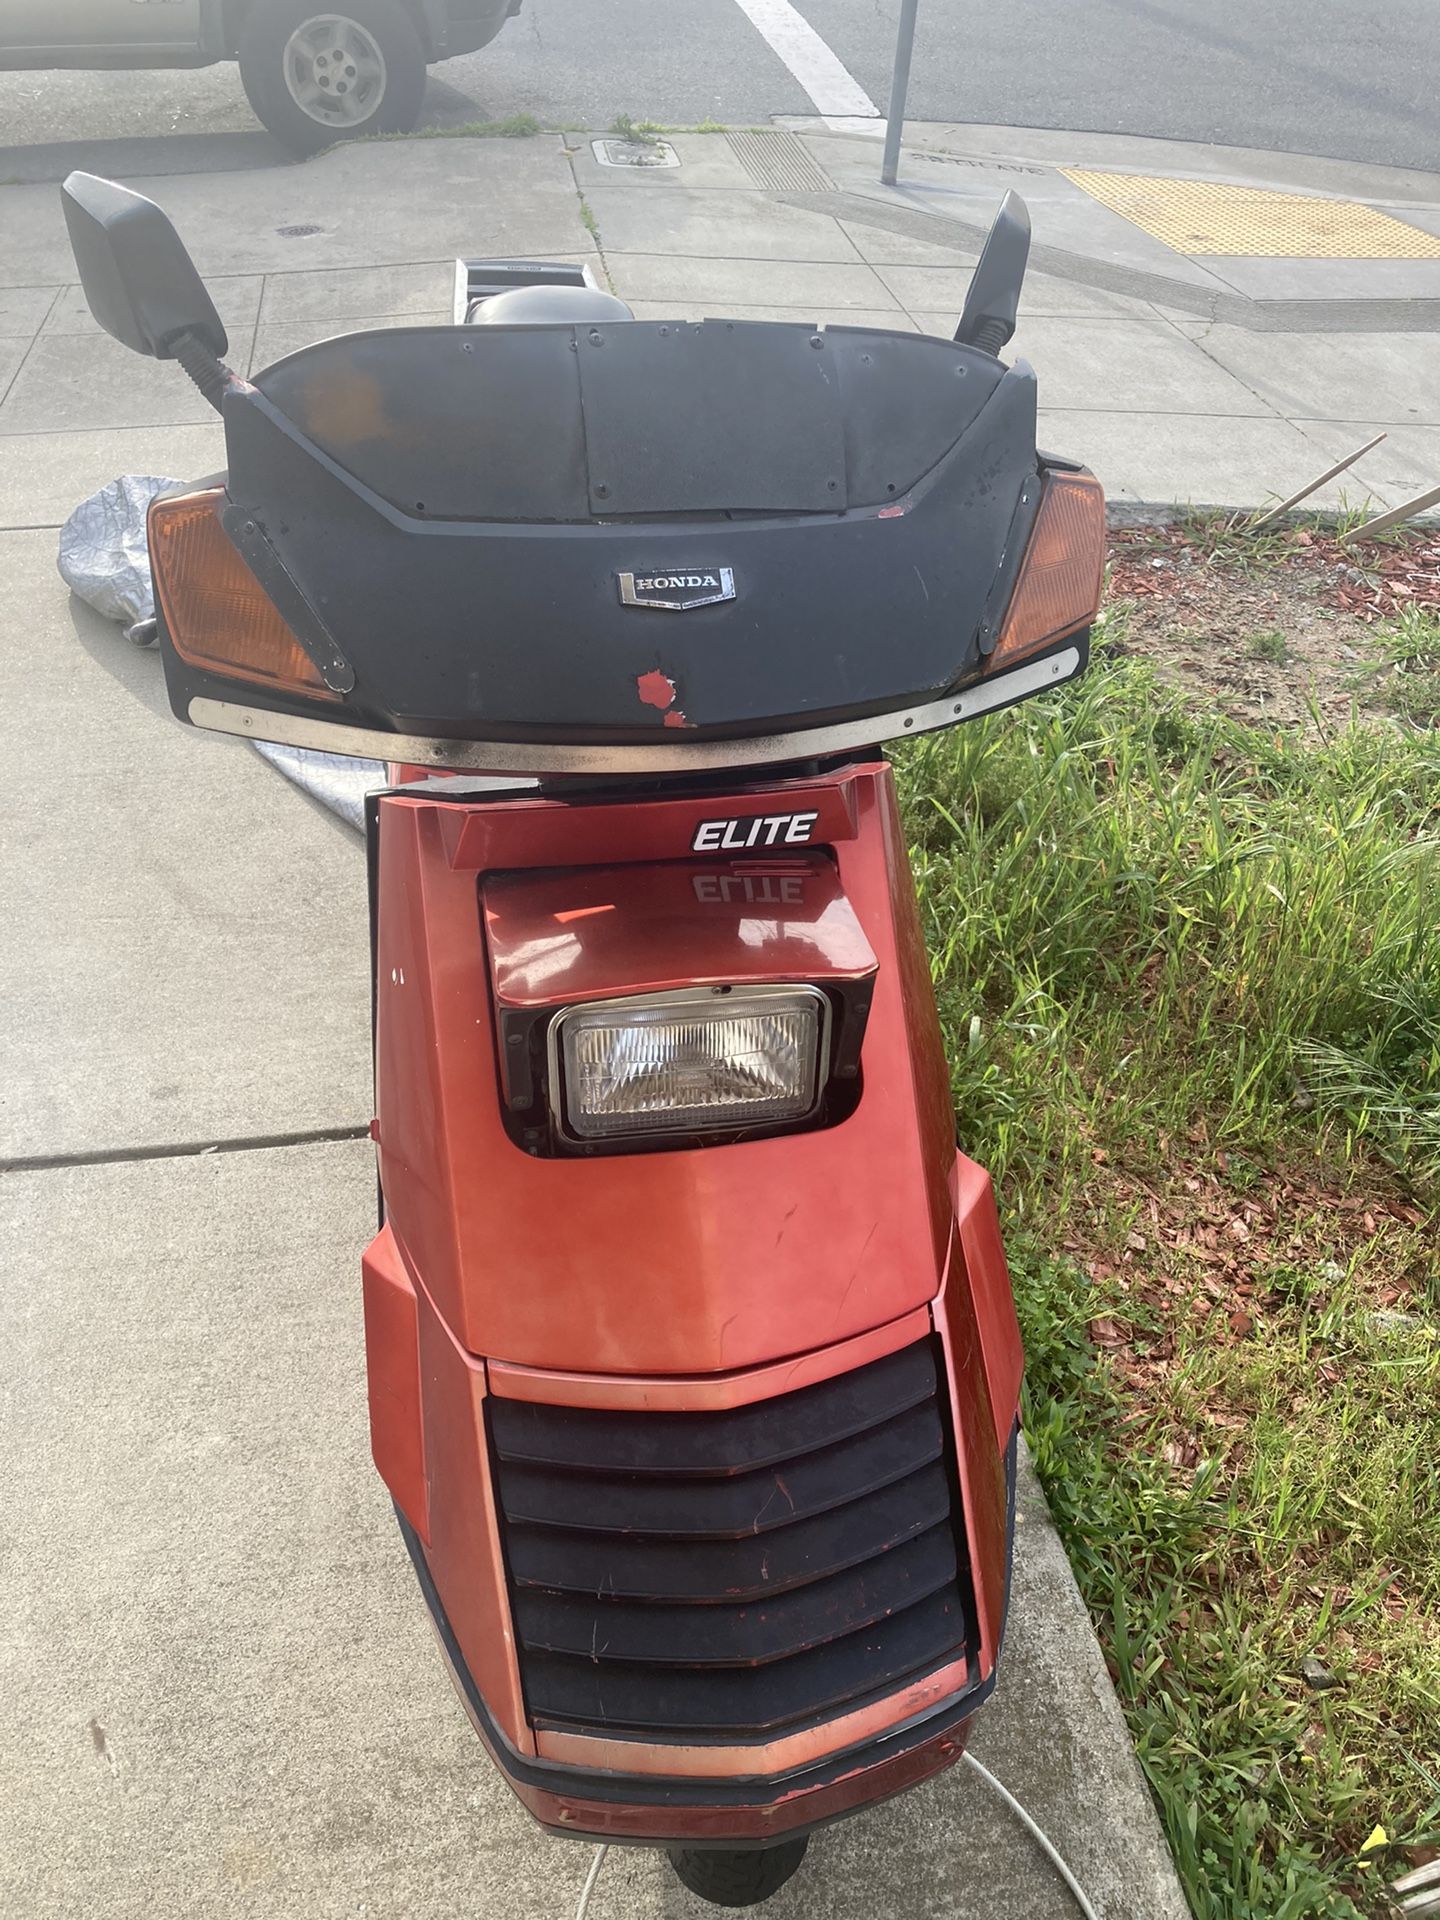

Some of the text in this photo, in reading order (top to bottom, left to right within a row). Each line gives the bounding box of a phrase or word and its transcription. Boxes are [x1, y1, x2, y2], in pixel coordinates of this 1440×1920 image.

[996, 164, 1046, 176] AVE
[635, 575, 719, 590] HONDA
[693, 812, 819, 852] ELITE
